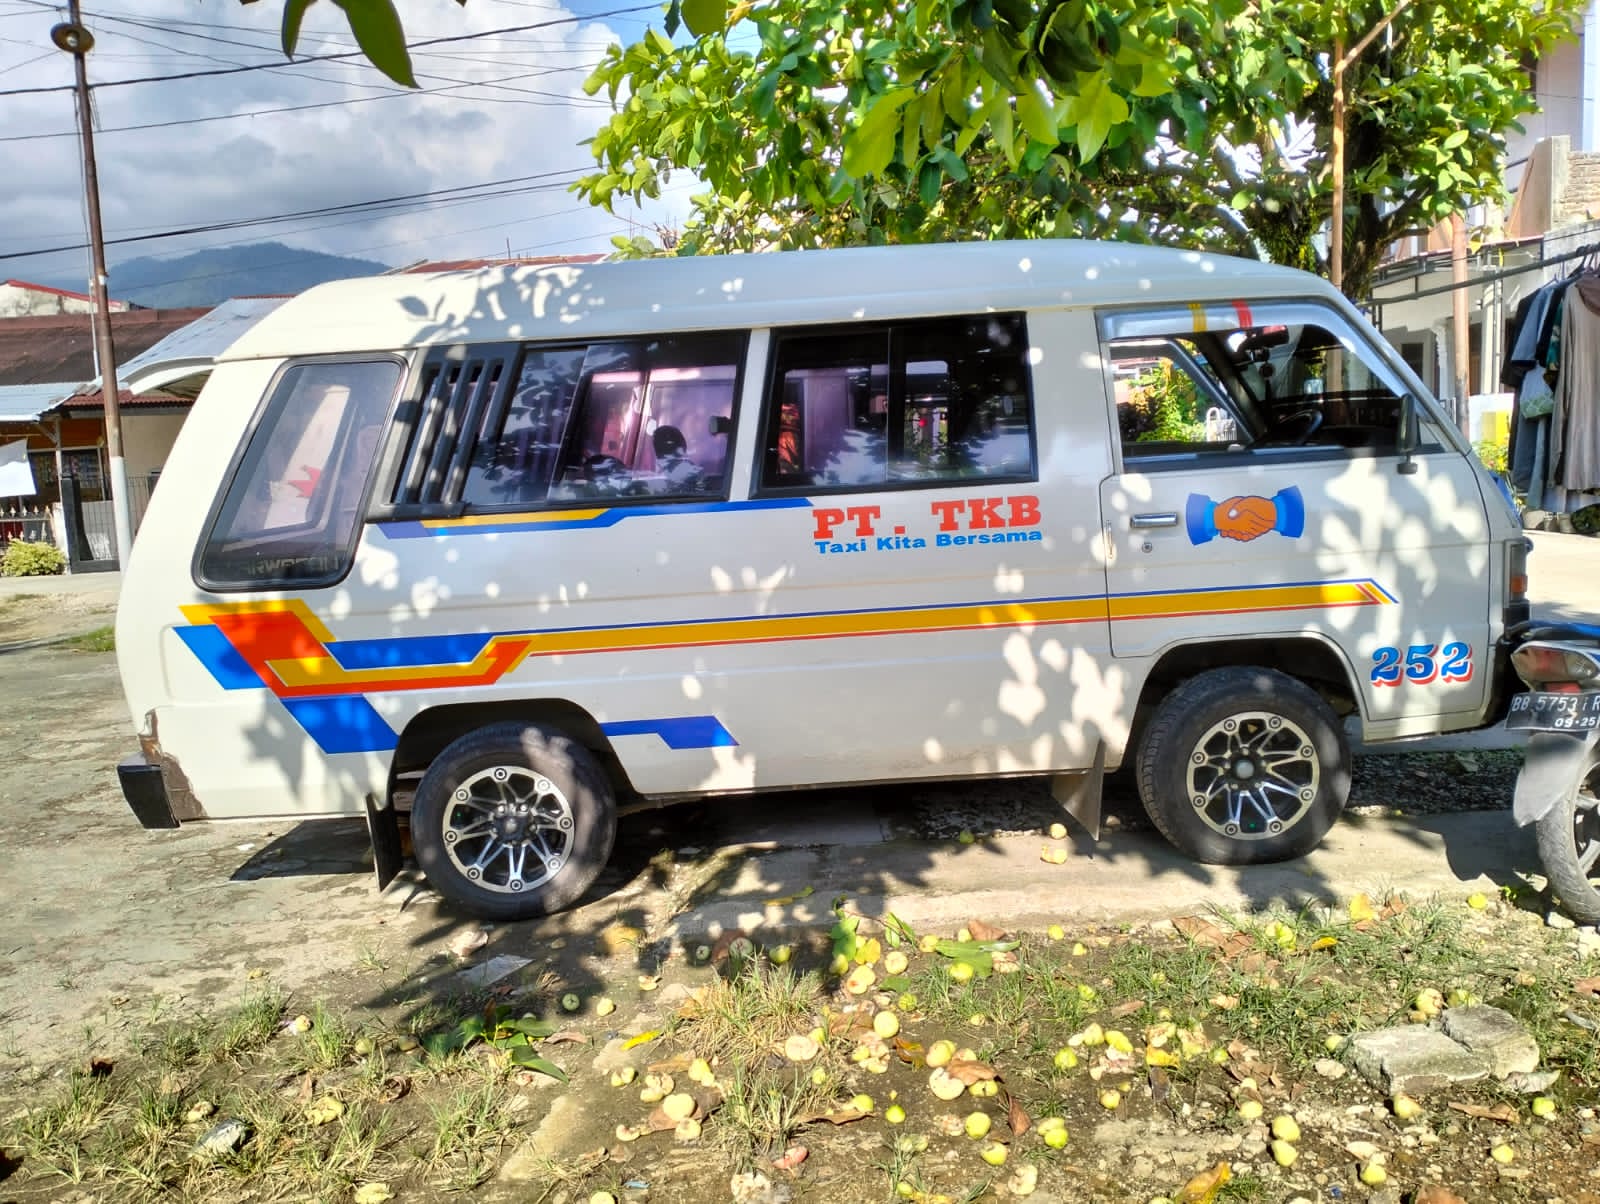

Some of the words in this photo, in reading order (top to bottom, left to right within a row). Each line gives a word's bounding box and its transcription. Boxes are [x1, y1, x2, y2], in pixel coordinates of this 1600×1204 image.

[812, 505, 906, 540] PT.
[931, 495, 1042, 532] TKB
[815, 538, 867, 554] Taxi
[876, 536, 926, 551] Kita
[936, 530, 1043, 547] Bersama
[1371, 641, 1474, 688] 252
[1511, 695, 1531, 712] BB
[1535, 695, 1579, 713] 5753
